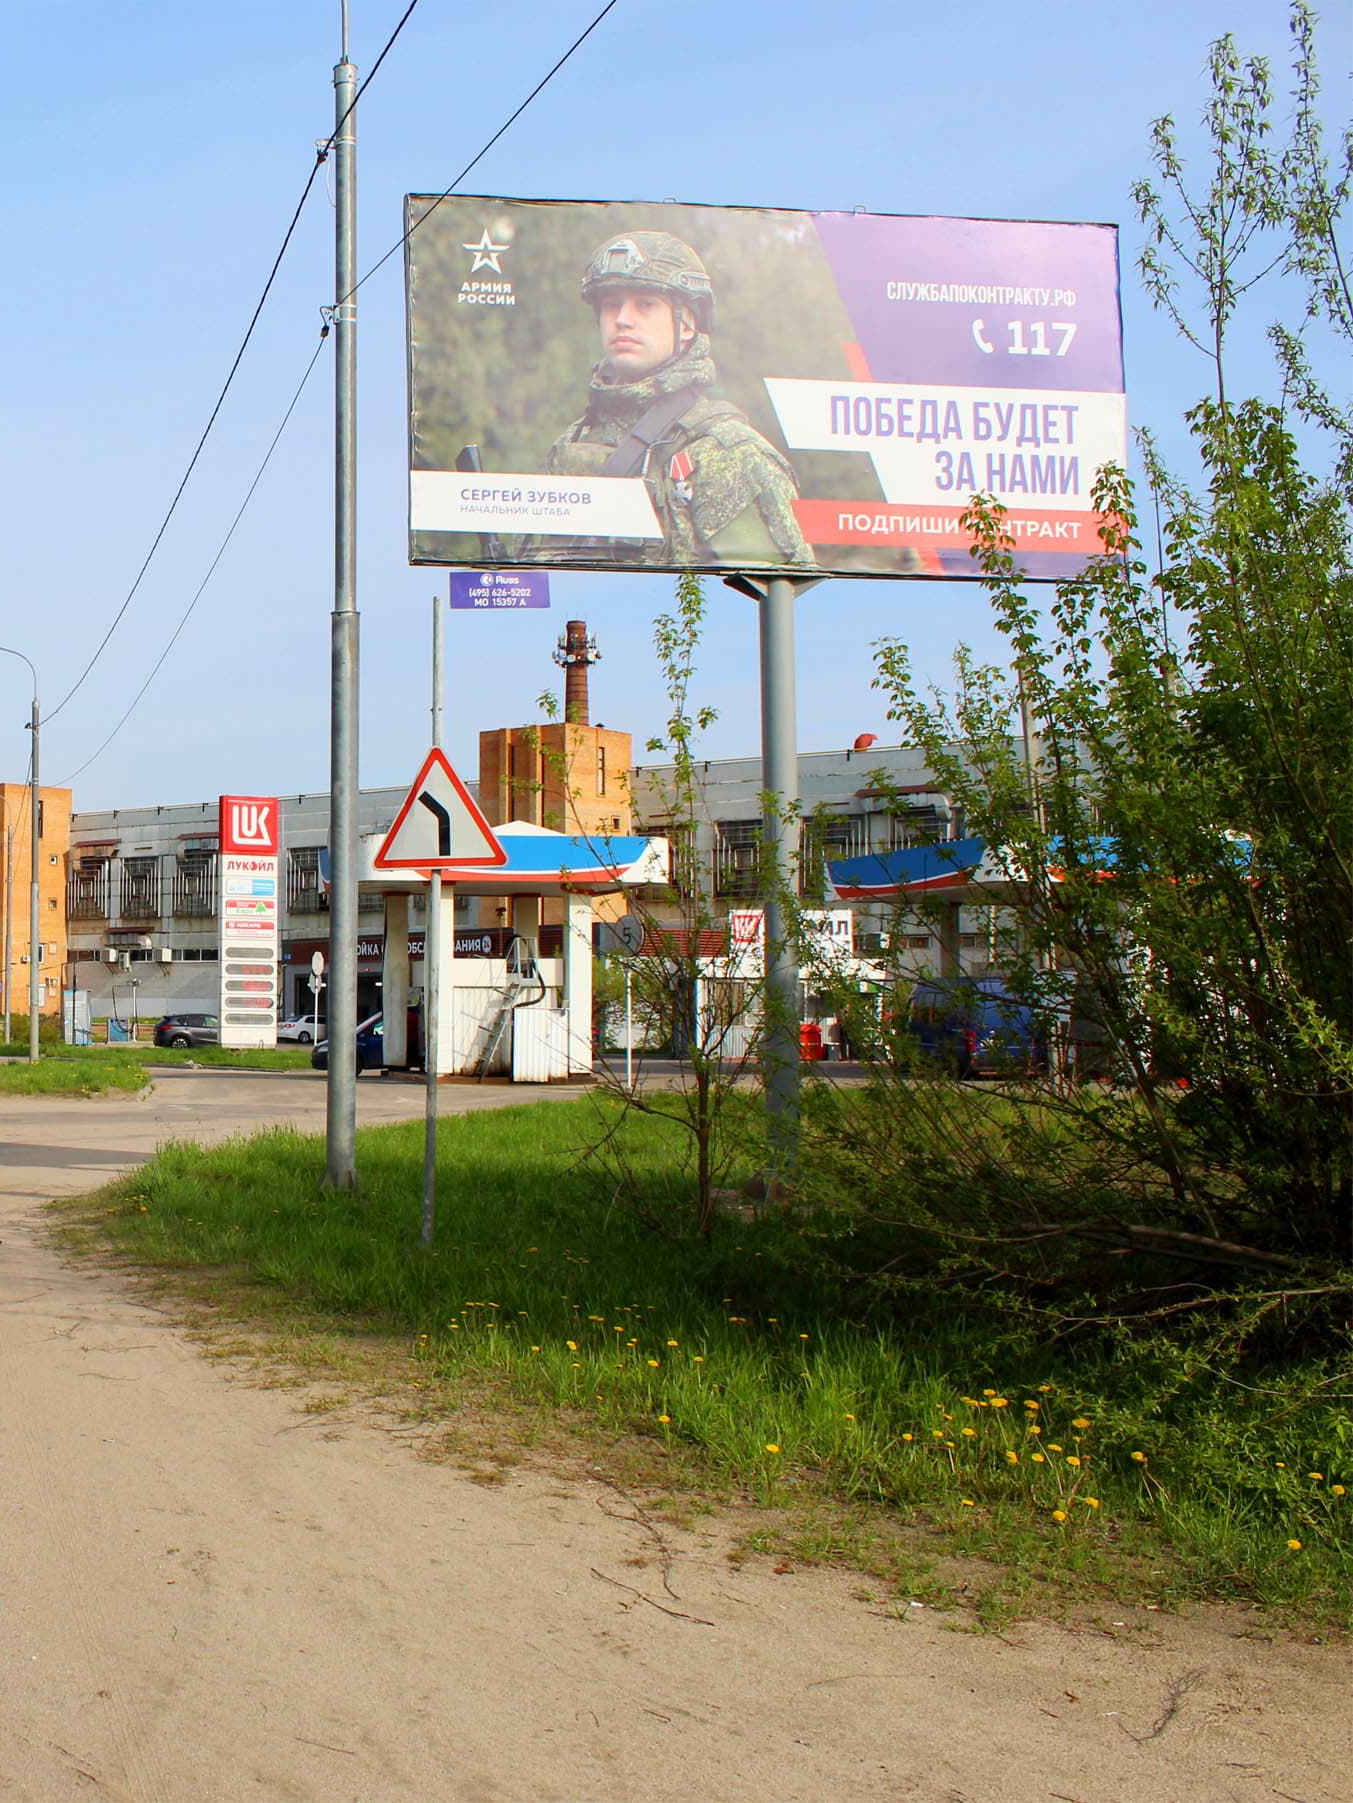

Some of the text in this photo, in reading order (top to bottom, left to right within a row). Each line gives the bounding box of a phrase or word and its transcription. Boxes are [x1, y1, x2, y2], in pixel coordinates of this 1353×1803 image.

[461, 281, 512, 294] АРМИЯ
[887, 281, 1077, 307] СЛУЖБАПОКОНТРАКТУ.РФ
[457, 293, 516, 305] РОССИИ
[1007, 320, 1078, 357] 117
[830, 395, 1080, 448] ПОБЕДА БУДЕТ
[935, 450, 1080, 496] ЗА НАМИ
[460, 487, 592, 505] СЕРГЕЙ ЗУБКОВ
[460, 504, 571, 517] НАЧАЛЬНИК ШТАБА
[838, 513, 960, 535] ПОДПИШИ
[469, 588, 532, 598] (495) 626-5202
[492, 598, 517, 607] 15357
[227, 860, 274, 871] ЛУКОЙЛ
